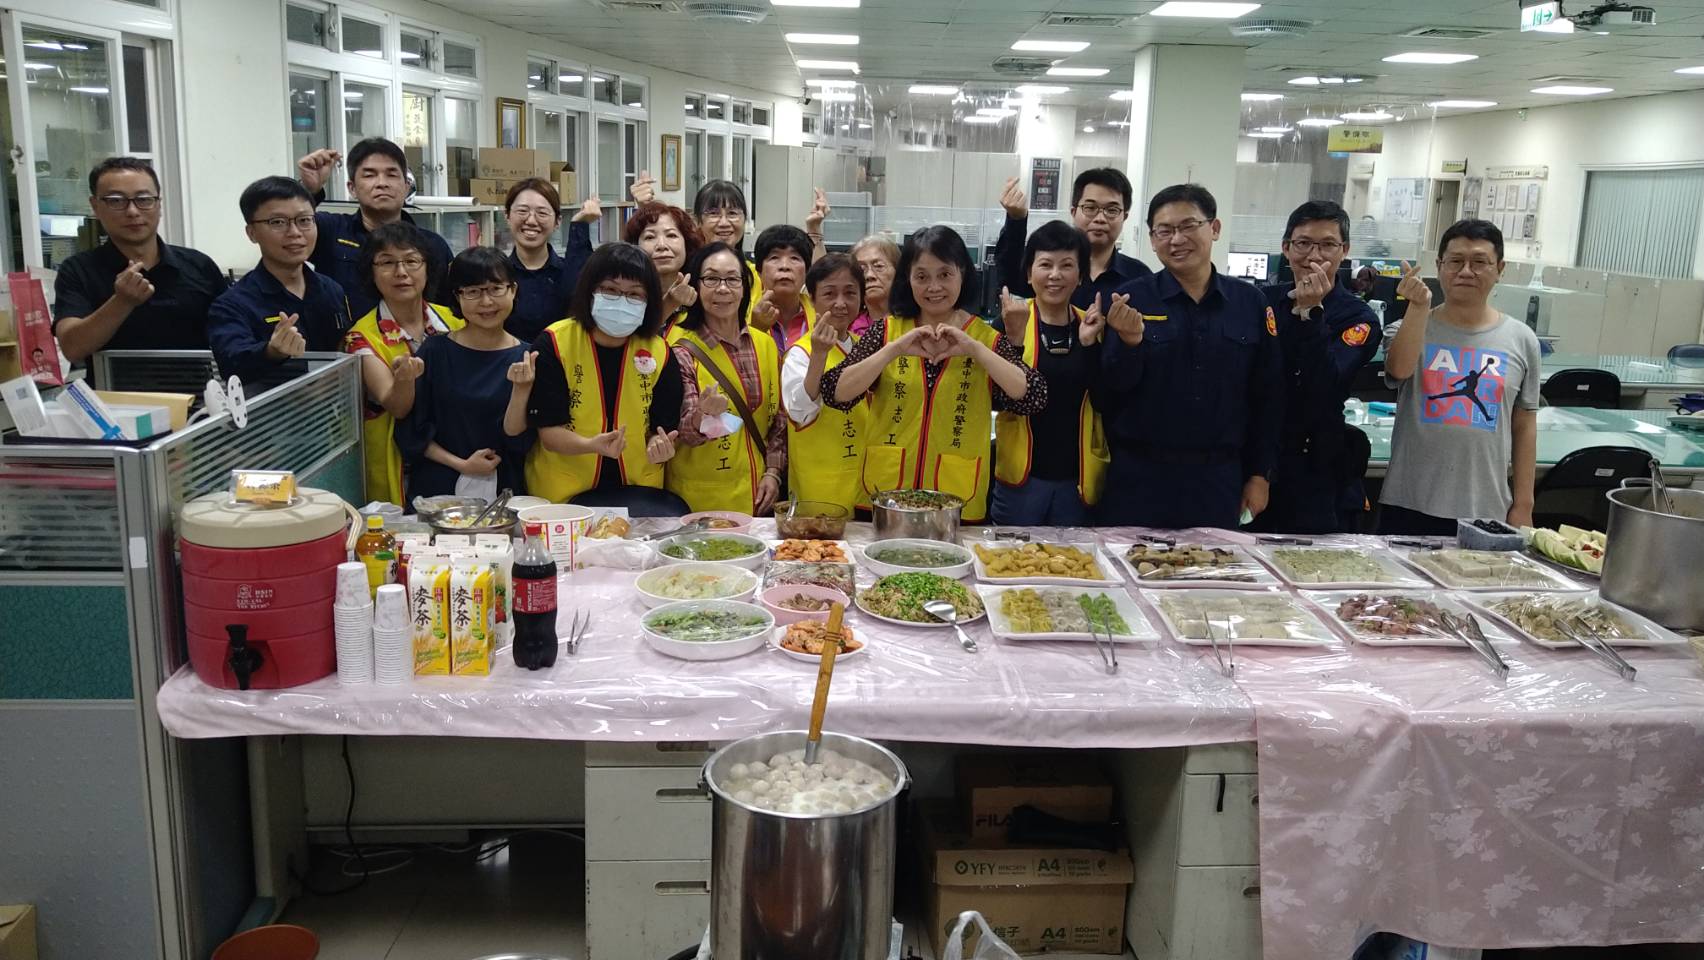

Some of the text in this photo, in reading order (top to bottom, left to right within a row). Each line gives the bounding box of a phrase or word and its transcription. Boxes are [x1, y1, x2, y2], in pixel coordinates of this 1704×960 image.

[1428, 348, 1501, 377] AIR
[884, 356, 909, 446] 警察志工
[842, 410, 858, 458] 志工
[971, 863, 996, 876] YFY
[1038, 858, 1060, 871] A4
[1041, 927, 1067, 939] A4
